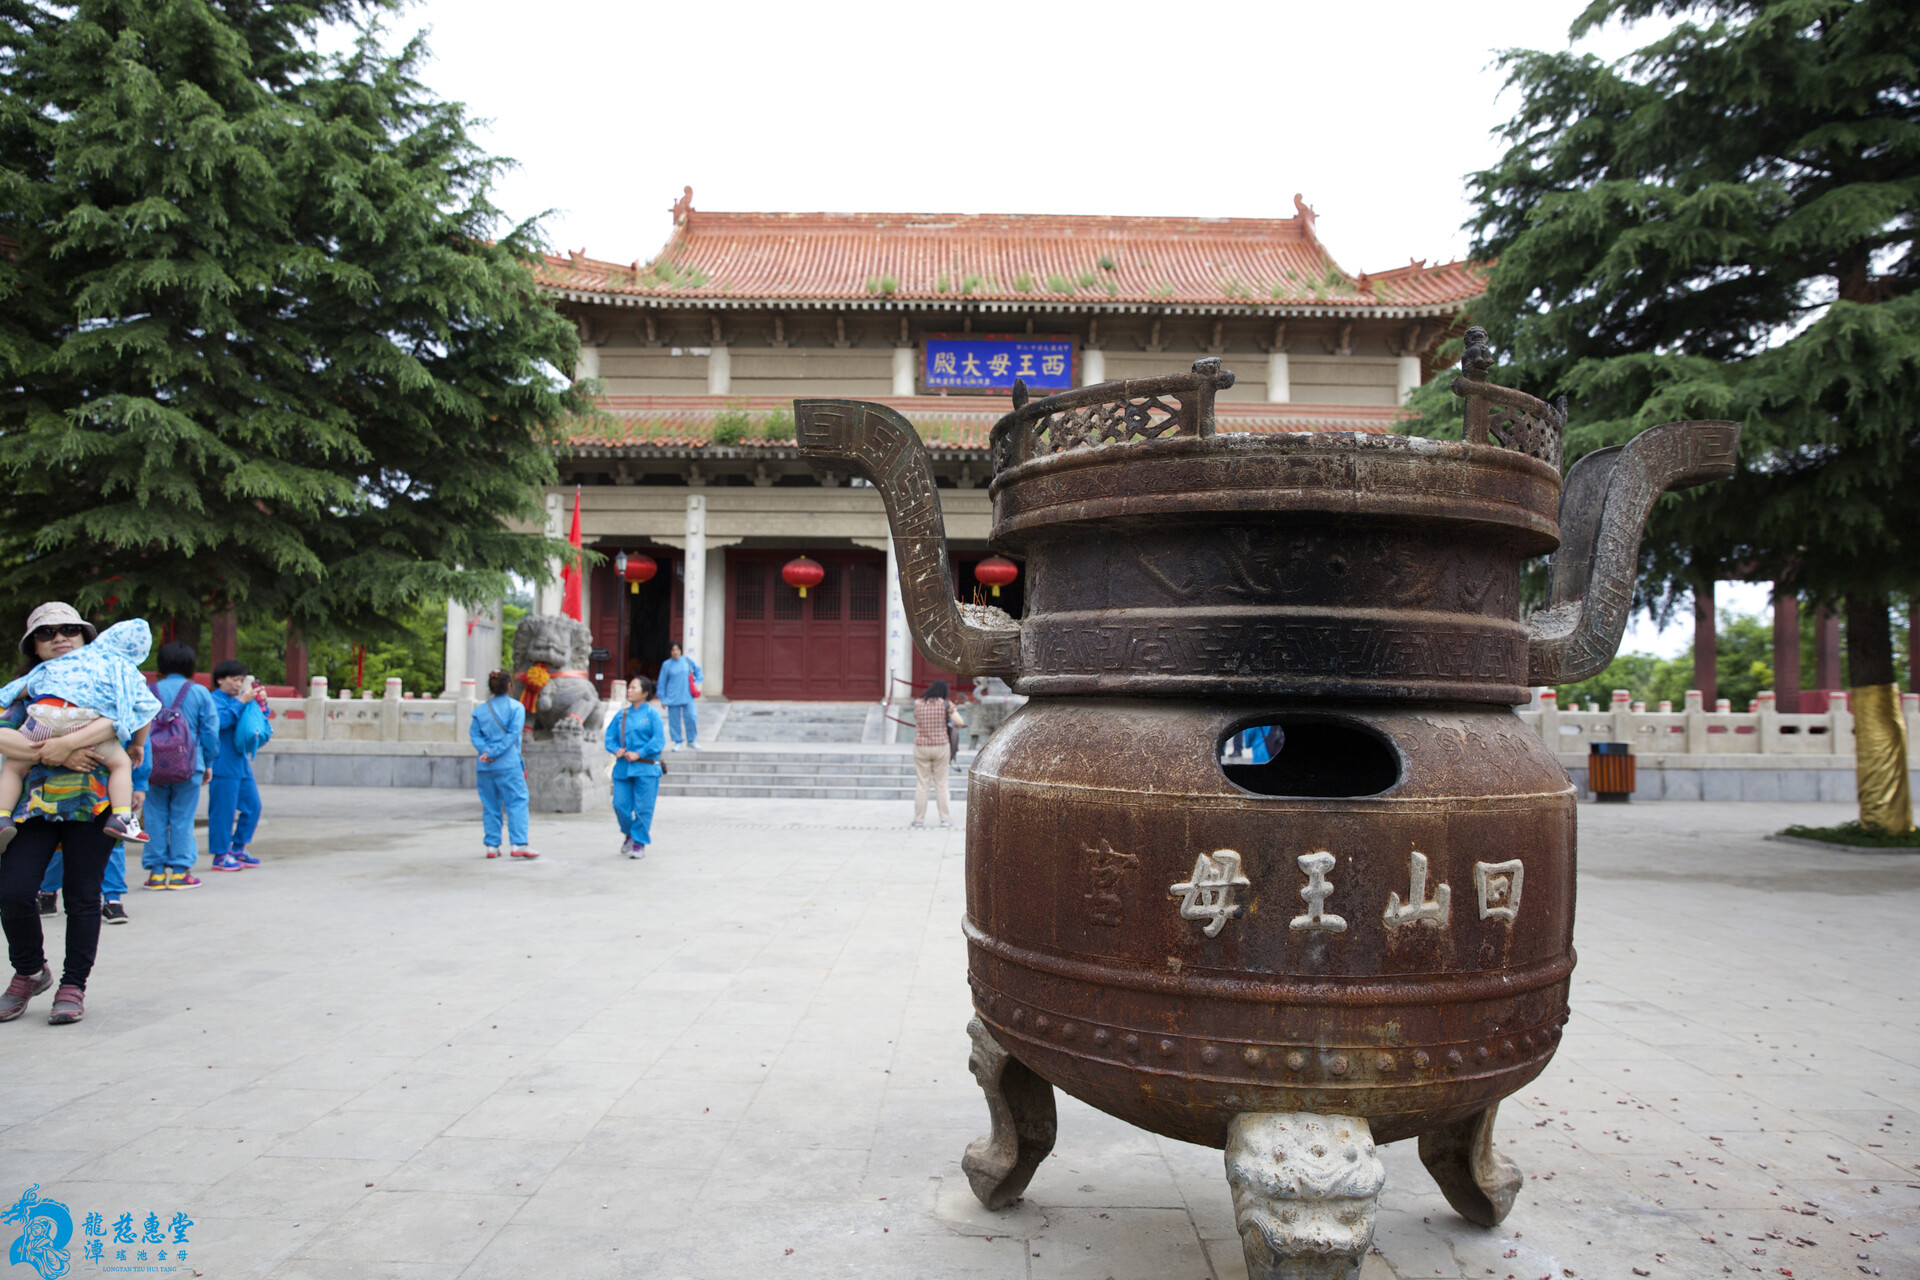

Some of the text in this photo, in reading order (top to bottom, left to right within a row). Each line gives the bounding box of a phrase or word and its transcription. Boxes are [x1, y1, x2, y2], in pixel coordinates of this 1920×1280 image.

[934, 352, 1065, 376] 西王母大殿
